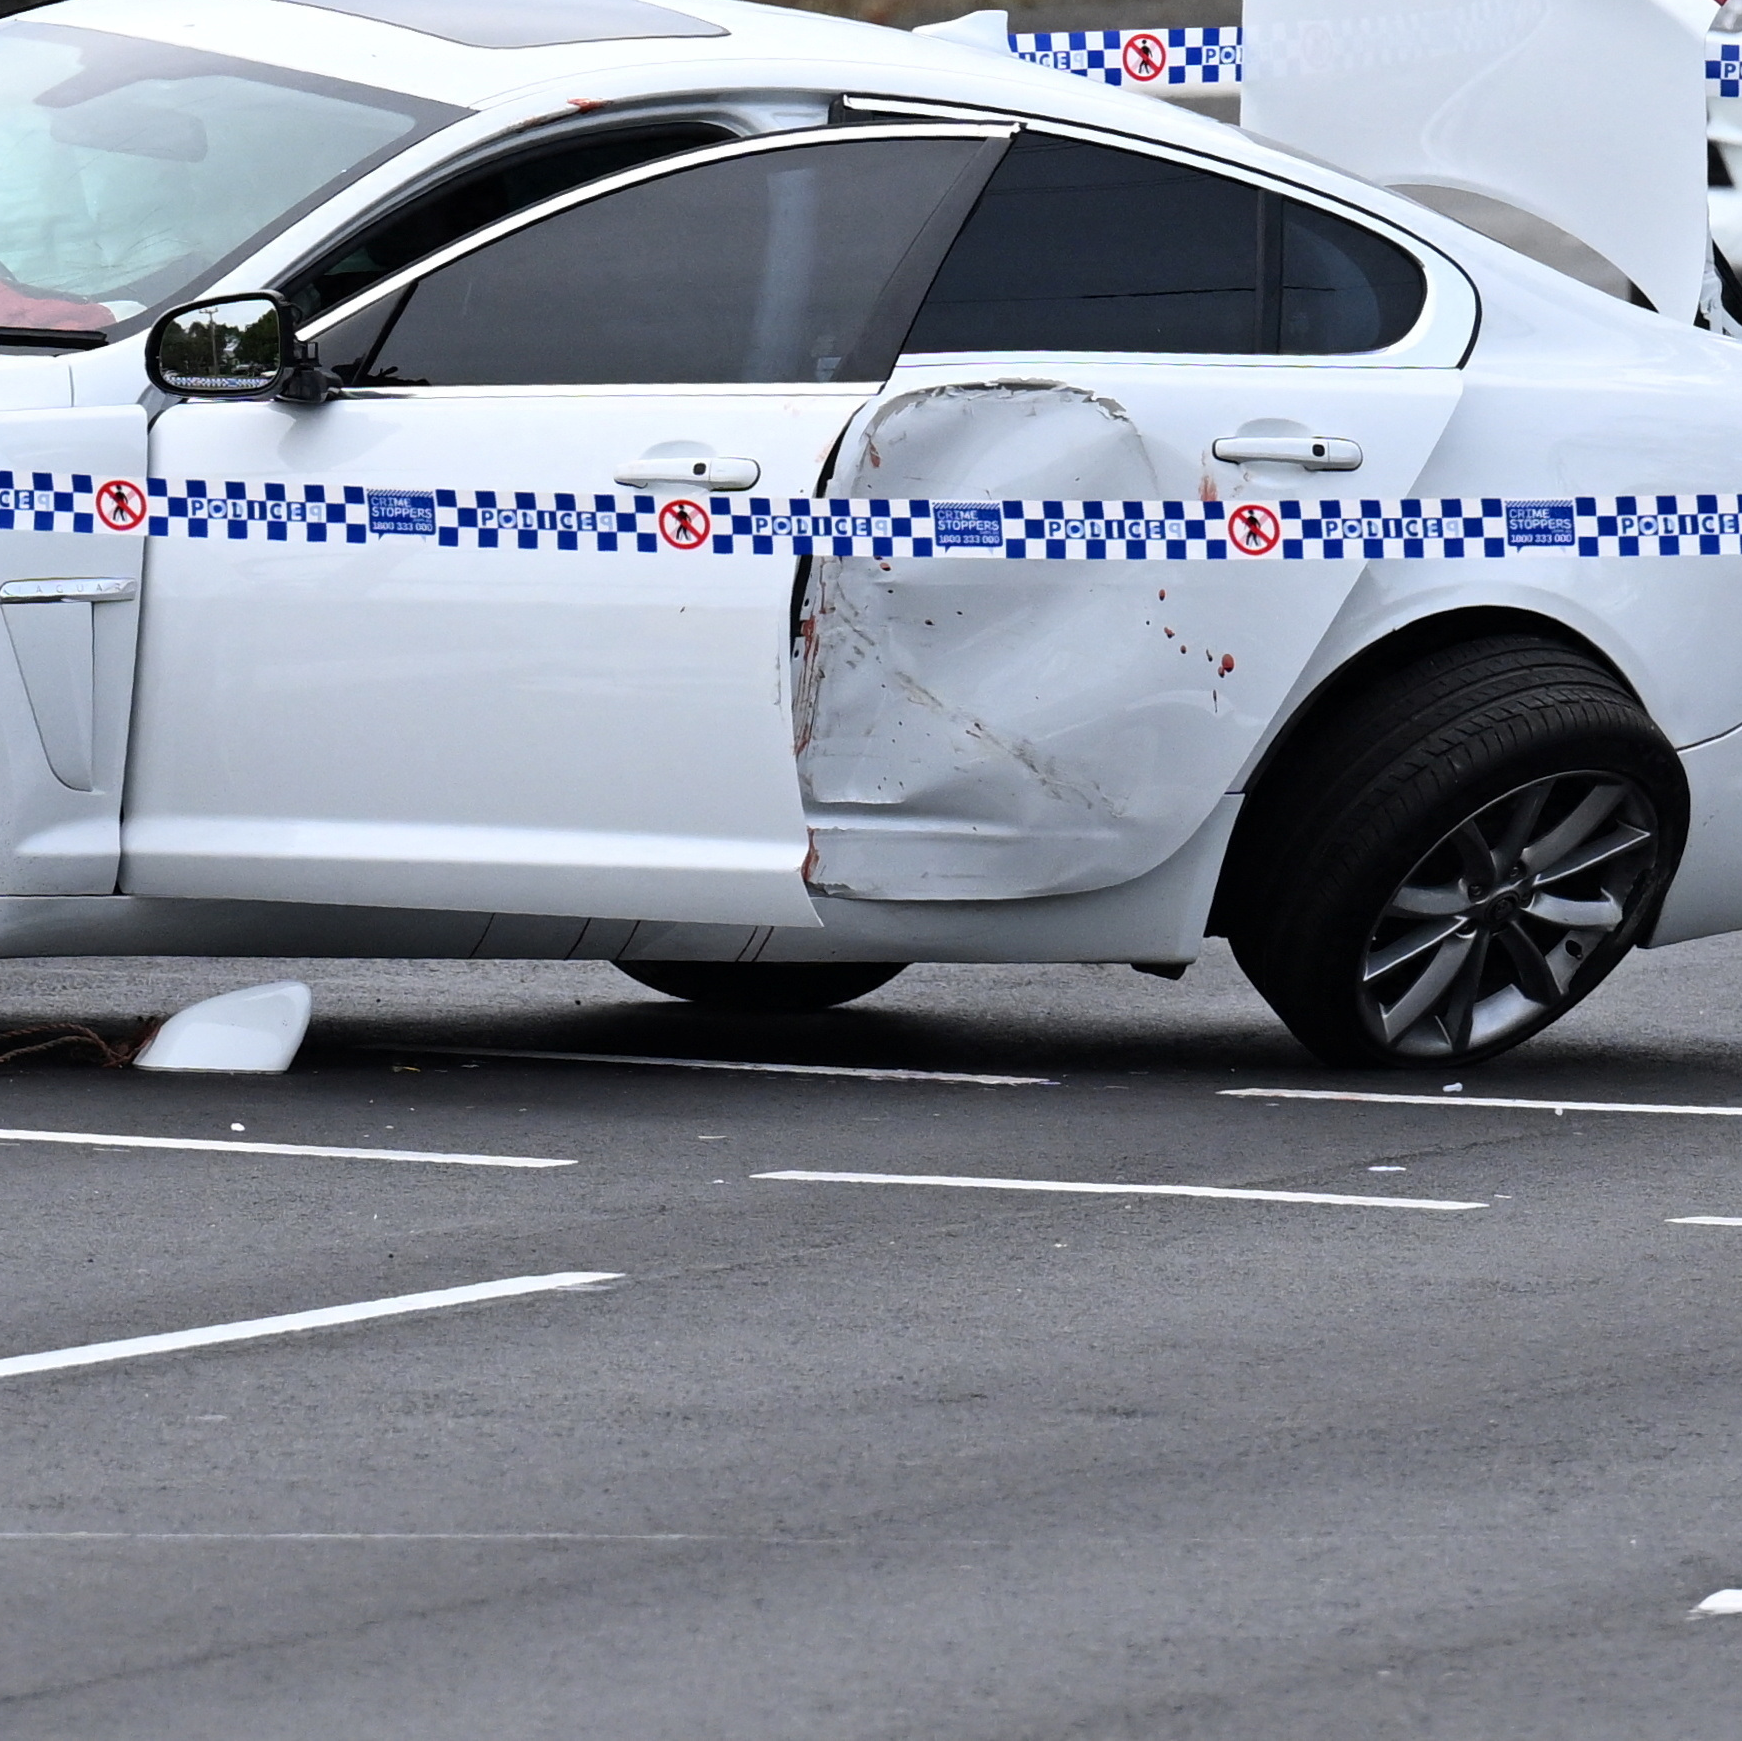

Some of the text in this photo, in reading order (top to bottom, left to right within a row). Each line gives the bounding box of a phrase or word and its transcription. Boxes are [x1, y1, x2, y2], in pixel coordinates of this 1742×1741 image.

[371, 497, 411, 508] CRIME
[192, 501, 303, 520] POLICE
[371, 507, 432, 518] STOPPERS
[937, 510, 978, 520] CRIME
[1509, 508, 1550, 518] CRIME
[481, 510, 592, 530] POLICE
[757, 516, 868, 535] POLICE
[938, 520, 999, 531] STOPPERS
[1510, 519, 1571, 530] STOPPERS
[1622, 516, 1736, 534] POLICE
[1050, 521, 1162, 539] POLICE
[1326, 520, 1438, 539] POLICE
